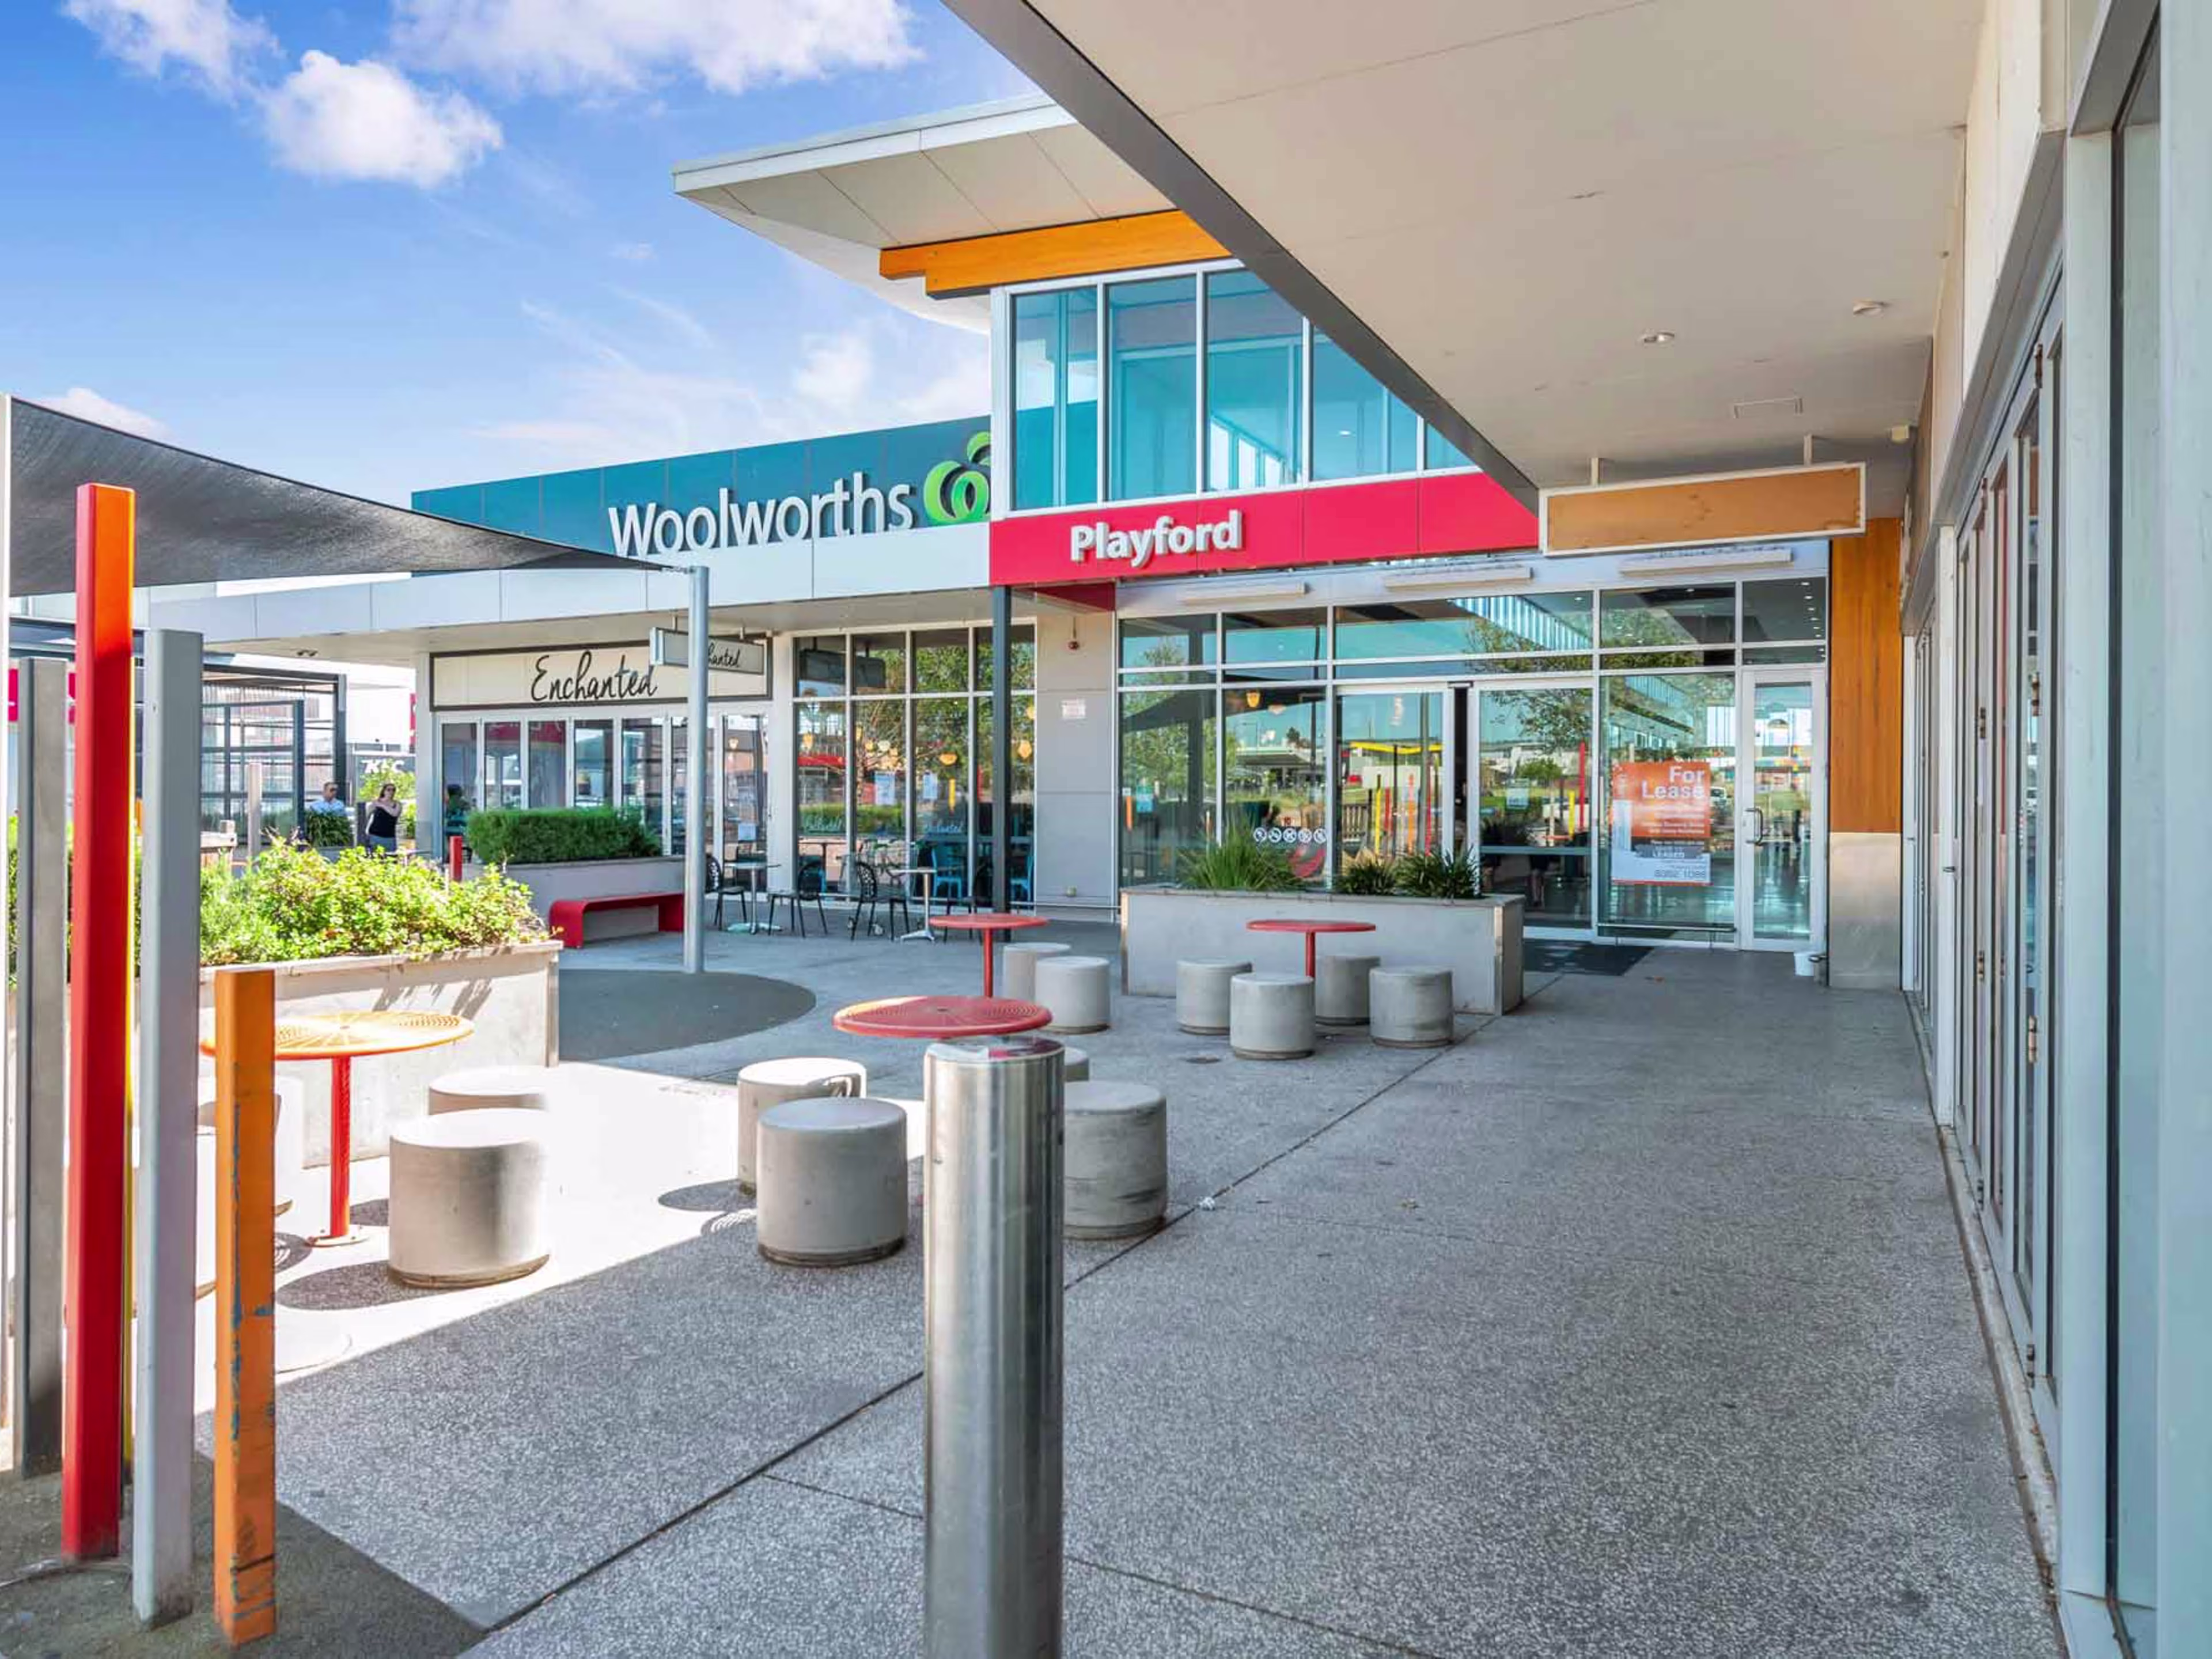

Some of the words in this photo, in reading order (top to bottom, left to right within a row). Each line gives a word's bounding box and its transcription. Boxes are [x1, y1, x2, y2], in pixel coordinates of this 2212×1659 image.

[608, 472, 913, 557] Woolworths
[1070, 509, 1243, 567] Playford
[708, 642, 741, 668] hanted
[531, 650, 658, 702] Enchanted
[1642, 781, 1704, 798] Lease
[1669, 766, 1705, 784] For
